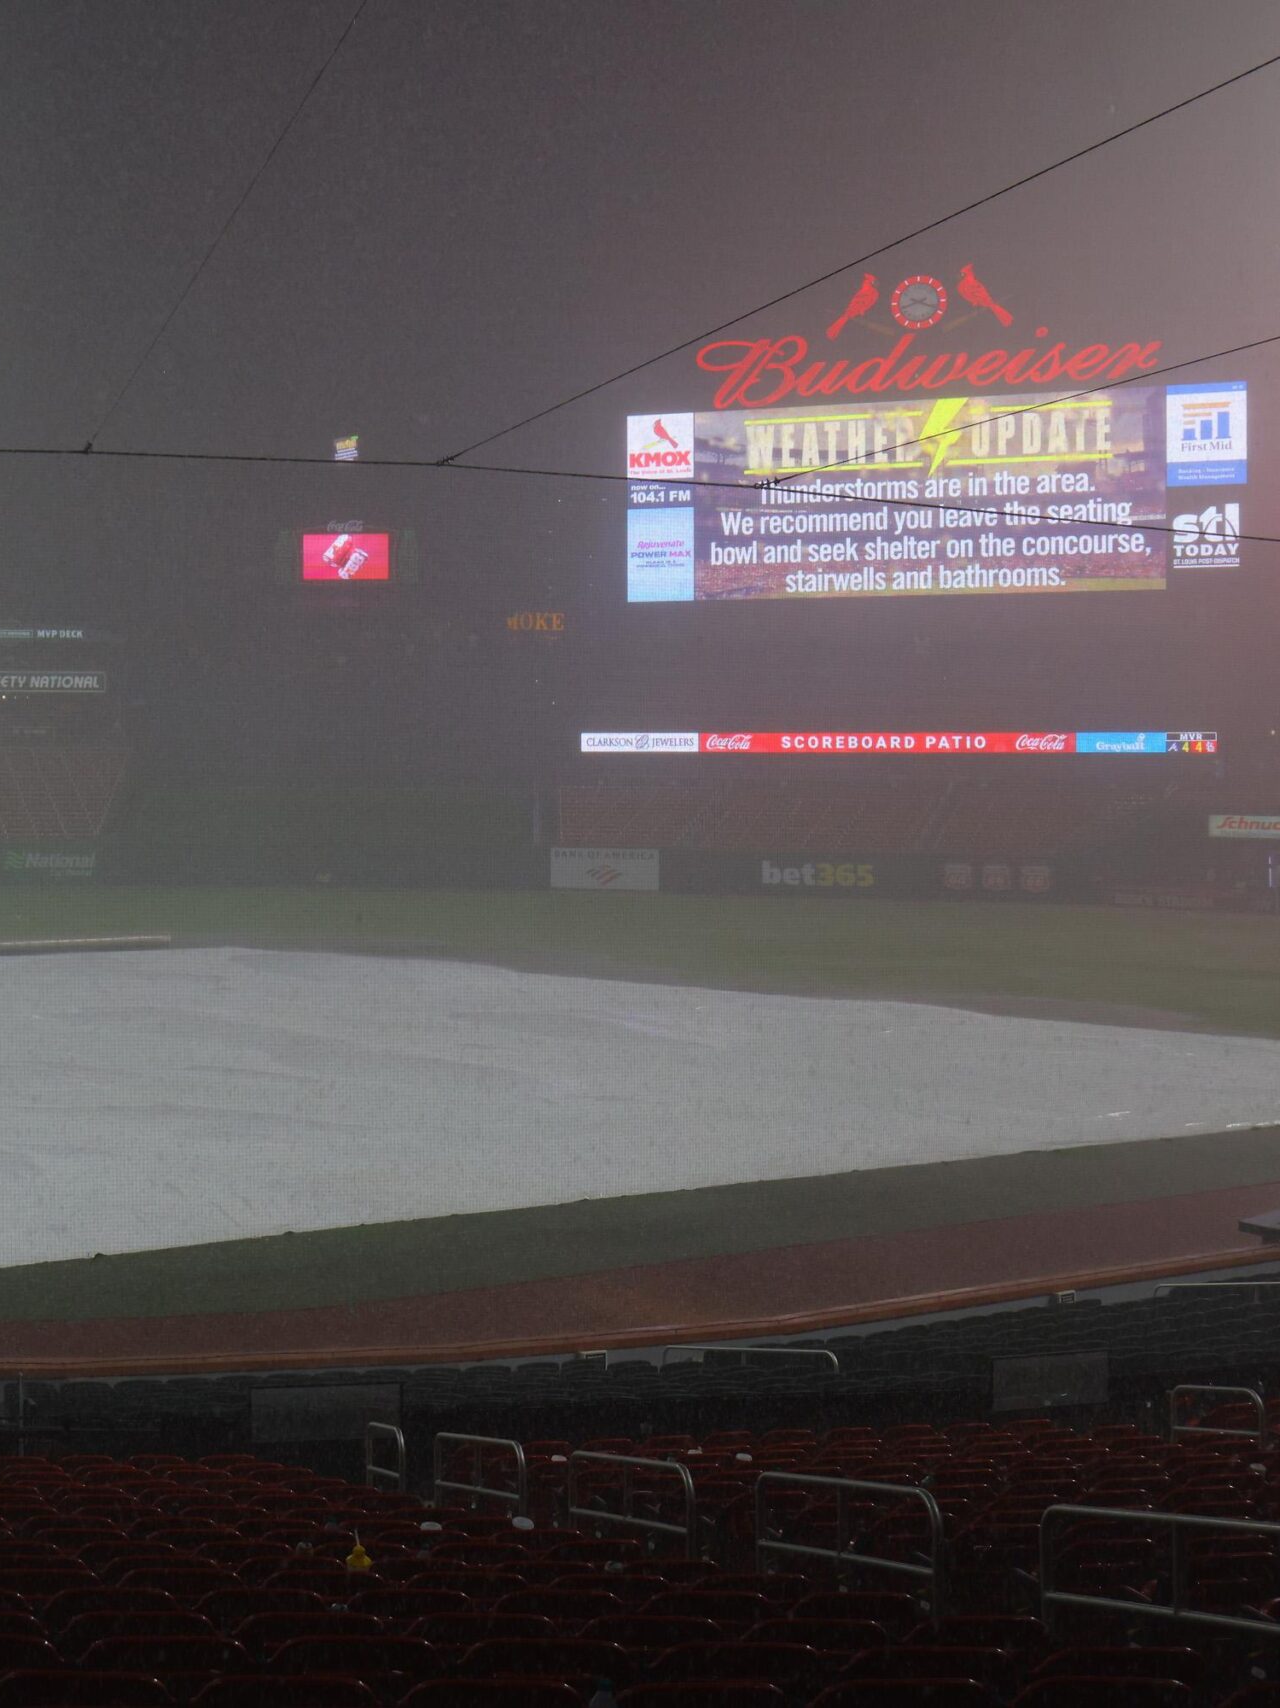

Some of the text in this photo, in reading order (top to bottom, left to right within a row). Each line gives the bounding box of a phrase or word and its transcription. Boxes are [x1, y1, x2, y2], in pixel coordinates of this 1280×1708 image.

[695, 327, 1162, 409] Budweiser
[745, 408, 1112, 469] WEATHER UPDATE
[1181, 439, 1233, 453] First Mid
[629, 451, 691, 468] KMOX
[759, 471, 1096, 505] Thunderstorms are in the area.
[631, 490, 691, 504] 104.1 FM
[721, 497, 1133, 536] We recommend you leave the seating
[1173, 503, 1240, 543] stl
[631, 550, 692, 559] POWER MAX
[710, 532, 1152, 566] bowl and seek shelter on the concourse,
[1173, 544, 1240, 557] TODAY
[785, 563, 1067, 594] stairwells and bathrooms.
[37, 629, 58, 639] MVP
[59, 629, 83, 639] DECK
[29, 675, 100, 689] NATIONAL
[586, 736, 695, 747] CLARKSON JEWELERS
[706, 733, 752, 750] Coca-Cola
[781, 735, 987, 749] SCOREBOARD PATIO
[1016, 733, 1069, 751] Coca-Cola
[1182, 741, 1190, 752] 4
[1195, 741, 1202, 752] 4
[24, 851, 97, 869] National
[761, 860, 875, 887] bet365
